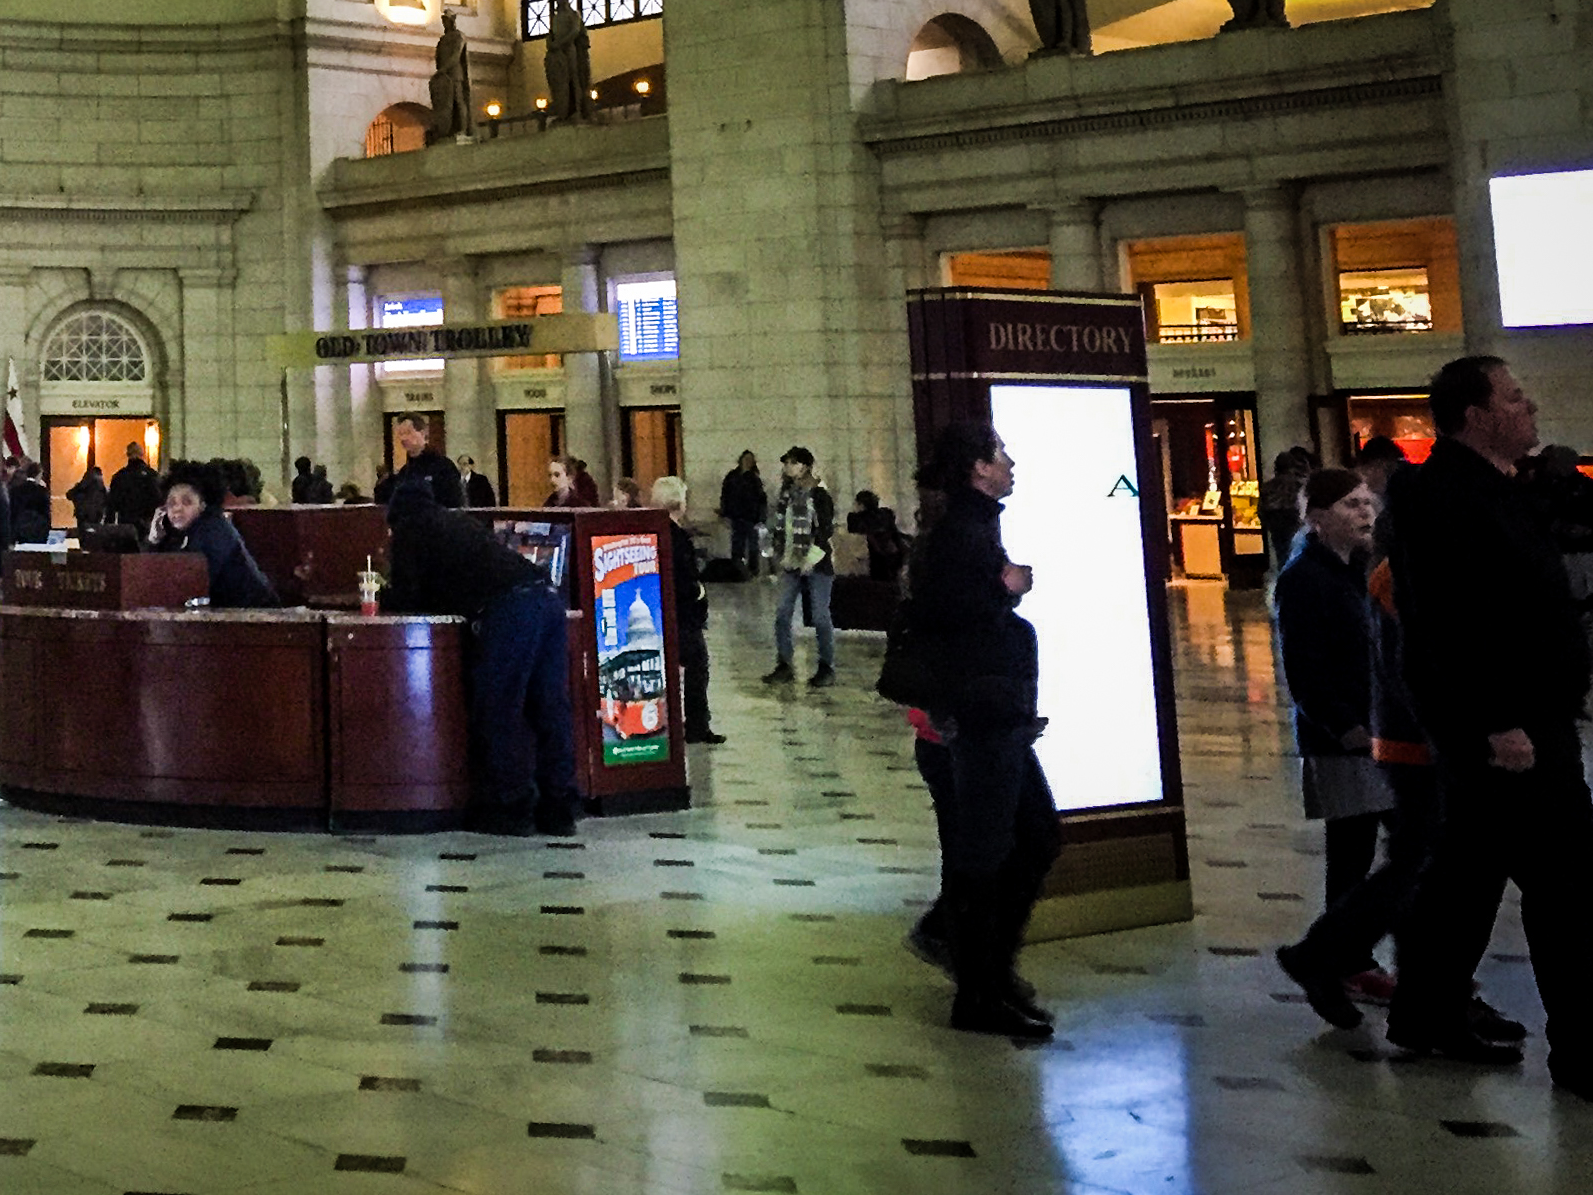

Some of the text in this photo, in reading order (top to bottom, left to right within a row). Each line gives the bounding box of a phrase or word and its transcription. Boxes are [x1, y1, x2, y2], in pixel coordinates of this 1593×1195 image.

[362, 330, 423, 354] TOWN
[429, 323, 533, 351] TROLLEY
[989, 323, 1133, 354] DIRECTORY
[71, 399, 120, 409] ELEVATOR
[1106, 474, 1139, 498] A
[594, 545, 657, 582] SIGHTSEEING
